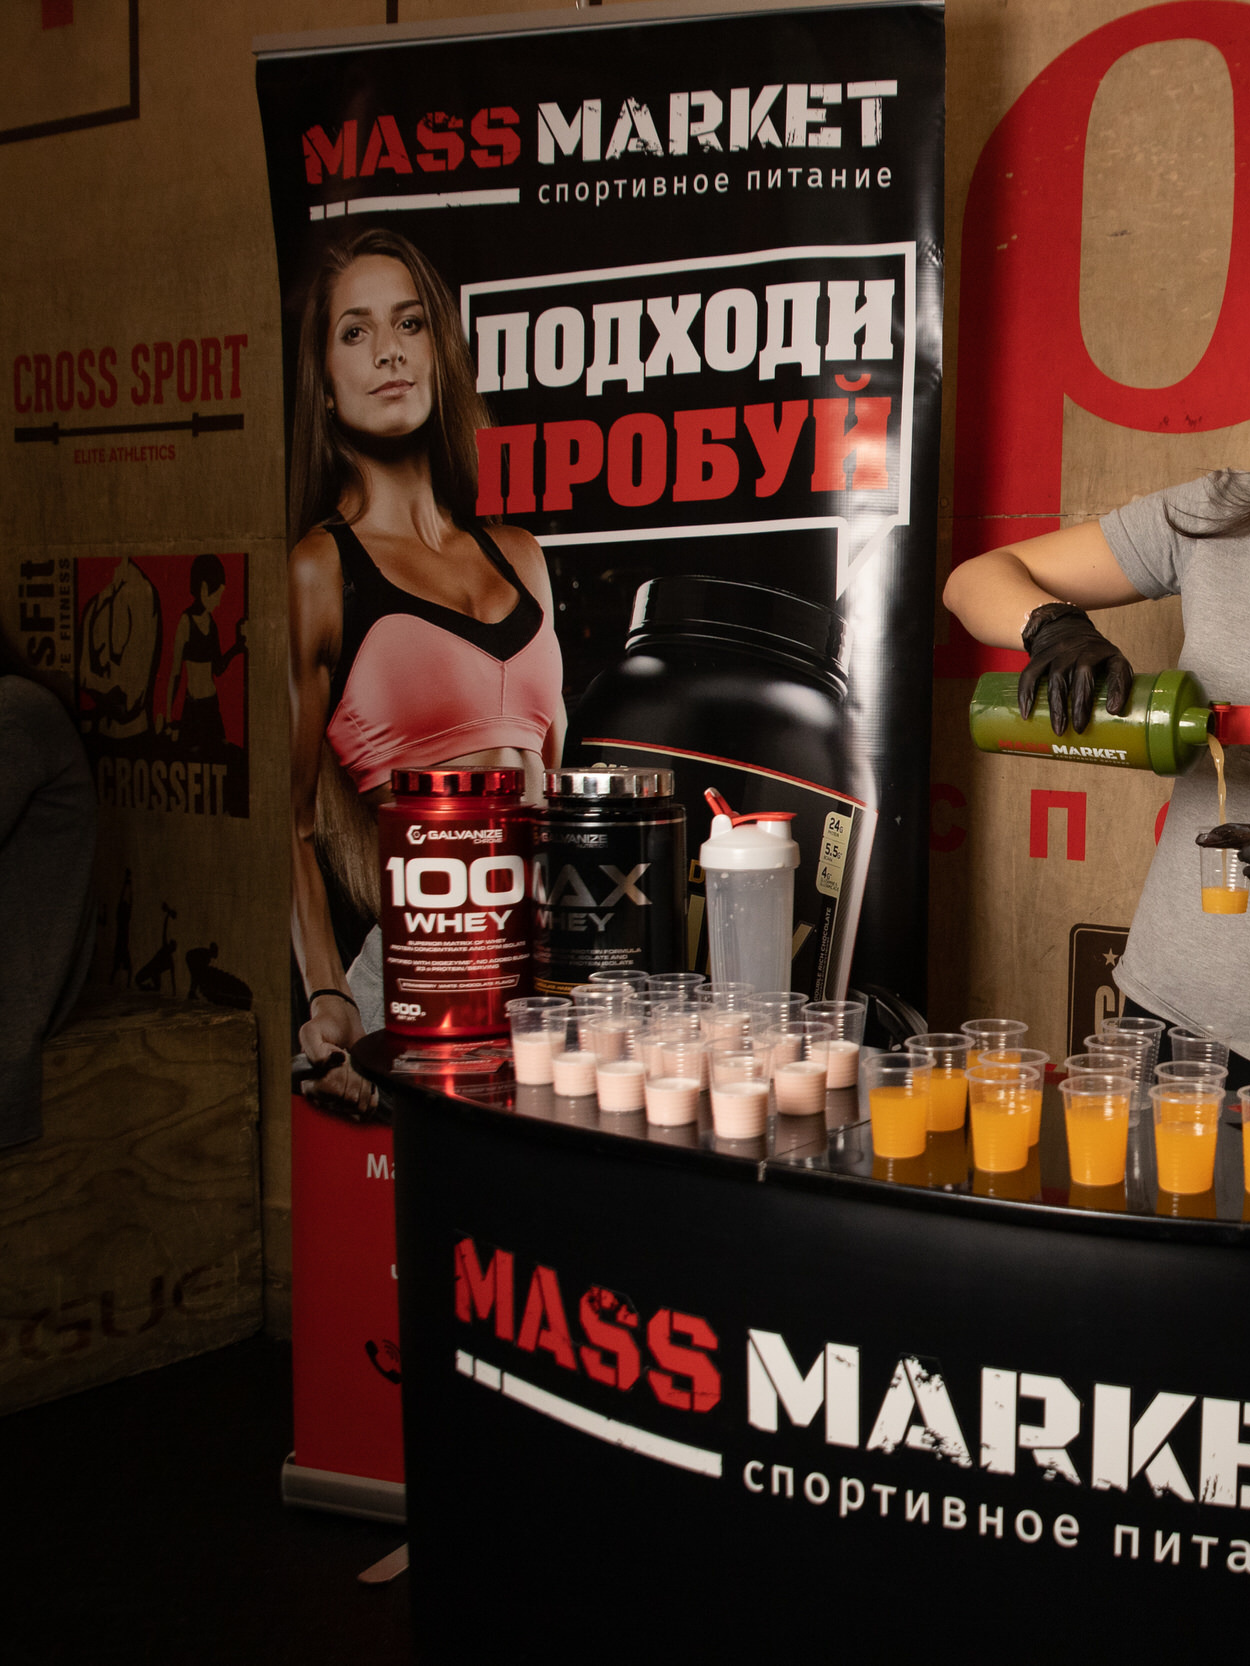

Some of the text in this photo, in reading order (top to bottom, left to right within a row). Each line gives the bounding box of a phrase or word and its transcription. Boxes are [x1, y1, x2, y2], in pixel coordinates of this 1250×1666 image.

[303, 79, 898, 184] MASS MARKET
[538, 165, 892, 206] спортивное питание
[476, 279, 895, 396] ПОДХОДИ
[14, 333, 248, 413] CROSS SPORT
[74, 445, 176, 464] ELITE ATHLETICS
[476, 373, 892, 516] ПРОБУЙ
[1051, 744, 1128, 761] MARKET
[427, 828, 504, 841] GALVANIZE
[385, 854, 525, 909] 100
[404, 909, 513, 934] WHEY
[821, 906, 833, 952] CHOCOLATE
[453, 1236, 722, 1413] MASS
[742, 1456, 1081, 1547] спортивное
